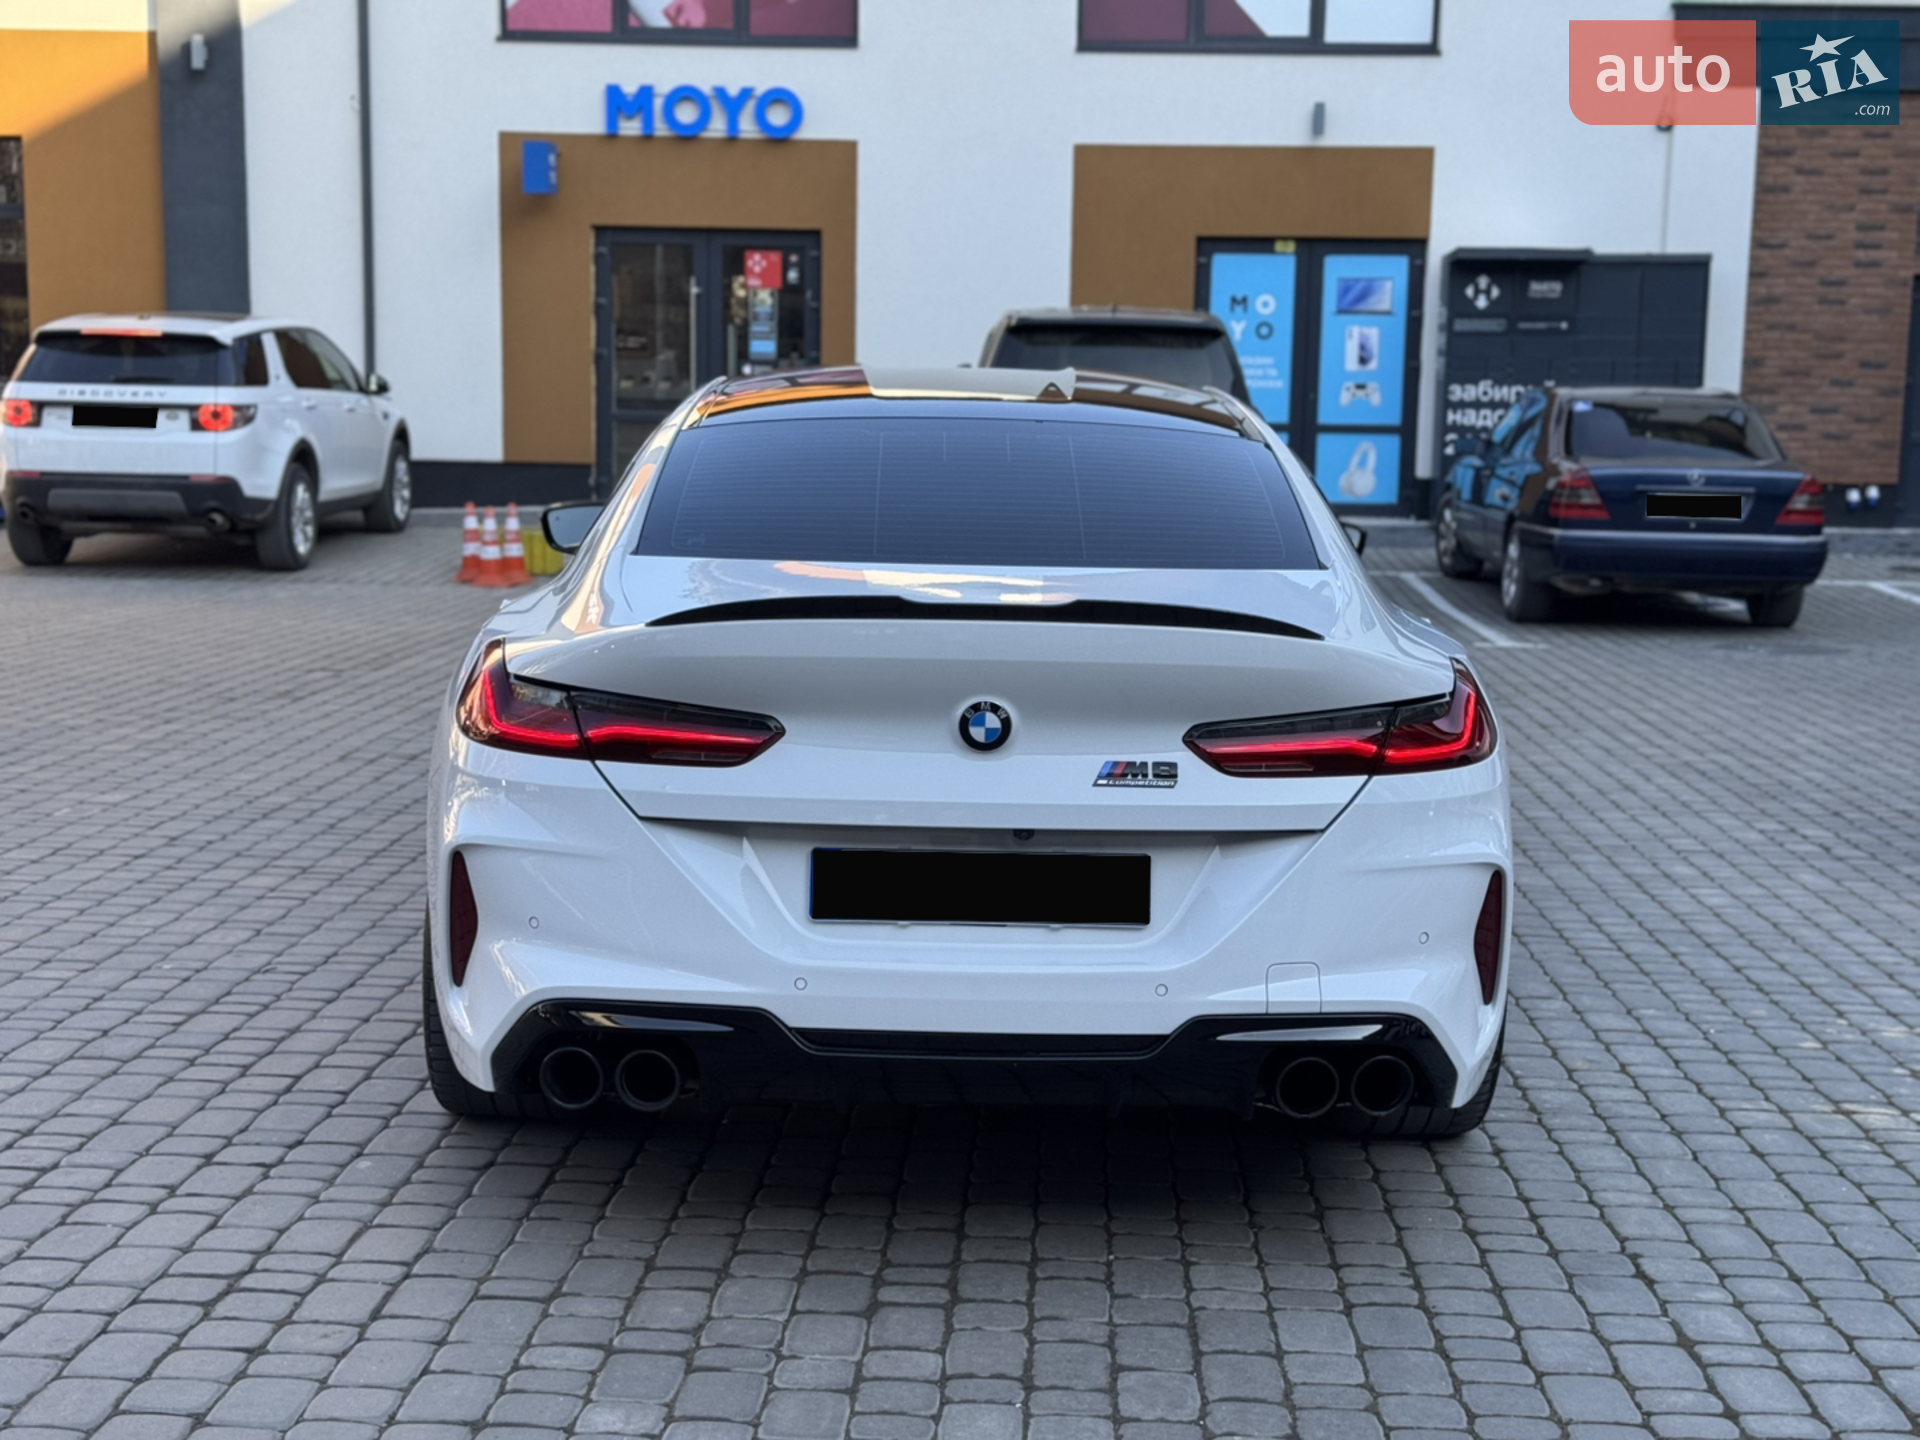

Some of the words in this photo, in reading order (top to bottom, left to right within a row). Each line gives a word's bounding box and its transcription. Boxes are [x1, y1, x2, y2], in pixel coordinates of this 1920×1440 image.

[605, 84, 804, 142] MOYO
[964, 701, 1008, 720] BMW
[1117, 760, 1179, 779] M8
